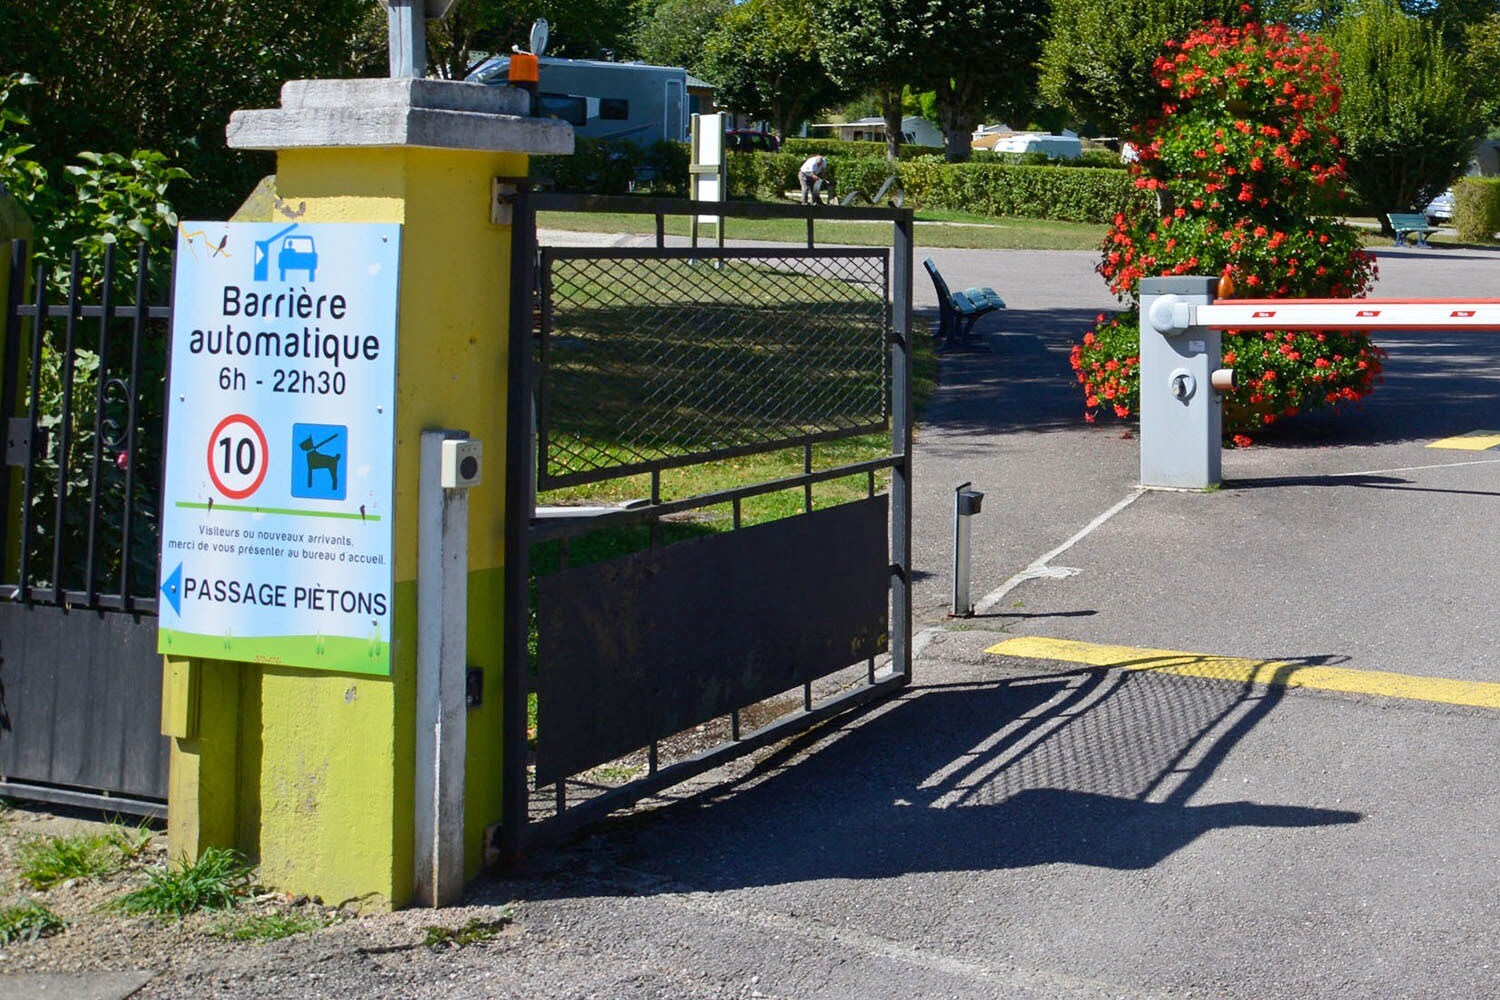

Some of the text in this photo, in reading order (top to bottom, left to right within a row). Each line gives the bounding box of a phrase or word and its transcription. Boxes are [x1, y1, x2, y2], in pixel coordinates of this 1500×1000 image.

[222, 286, 347, 319] Barrière
[189, 324, 380, 367] automatique
[219, 367, 246, 391] 6h
[272, 369, 346, 395] 22h30
[219, 437, 256, 475] 10
[198, 525, 240, 538] Visiteurs
[243, 529, 255, 539] ou
[257, 530, 304, 543] nouveaux
[168, 539, 196, 550] merci
[198, 541, 209, 551] de
[213, 544, 236, 553] vous
[238, 544, 285, 558] présenter
[287, 548, 300, 558] au
[302, 547, 337, 561] bureau
[184, 577, 287, 608] PASSAGE
